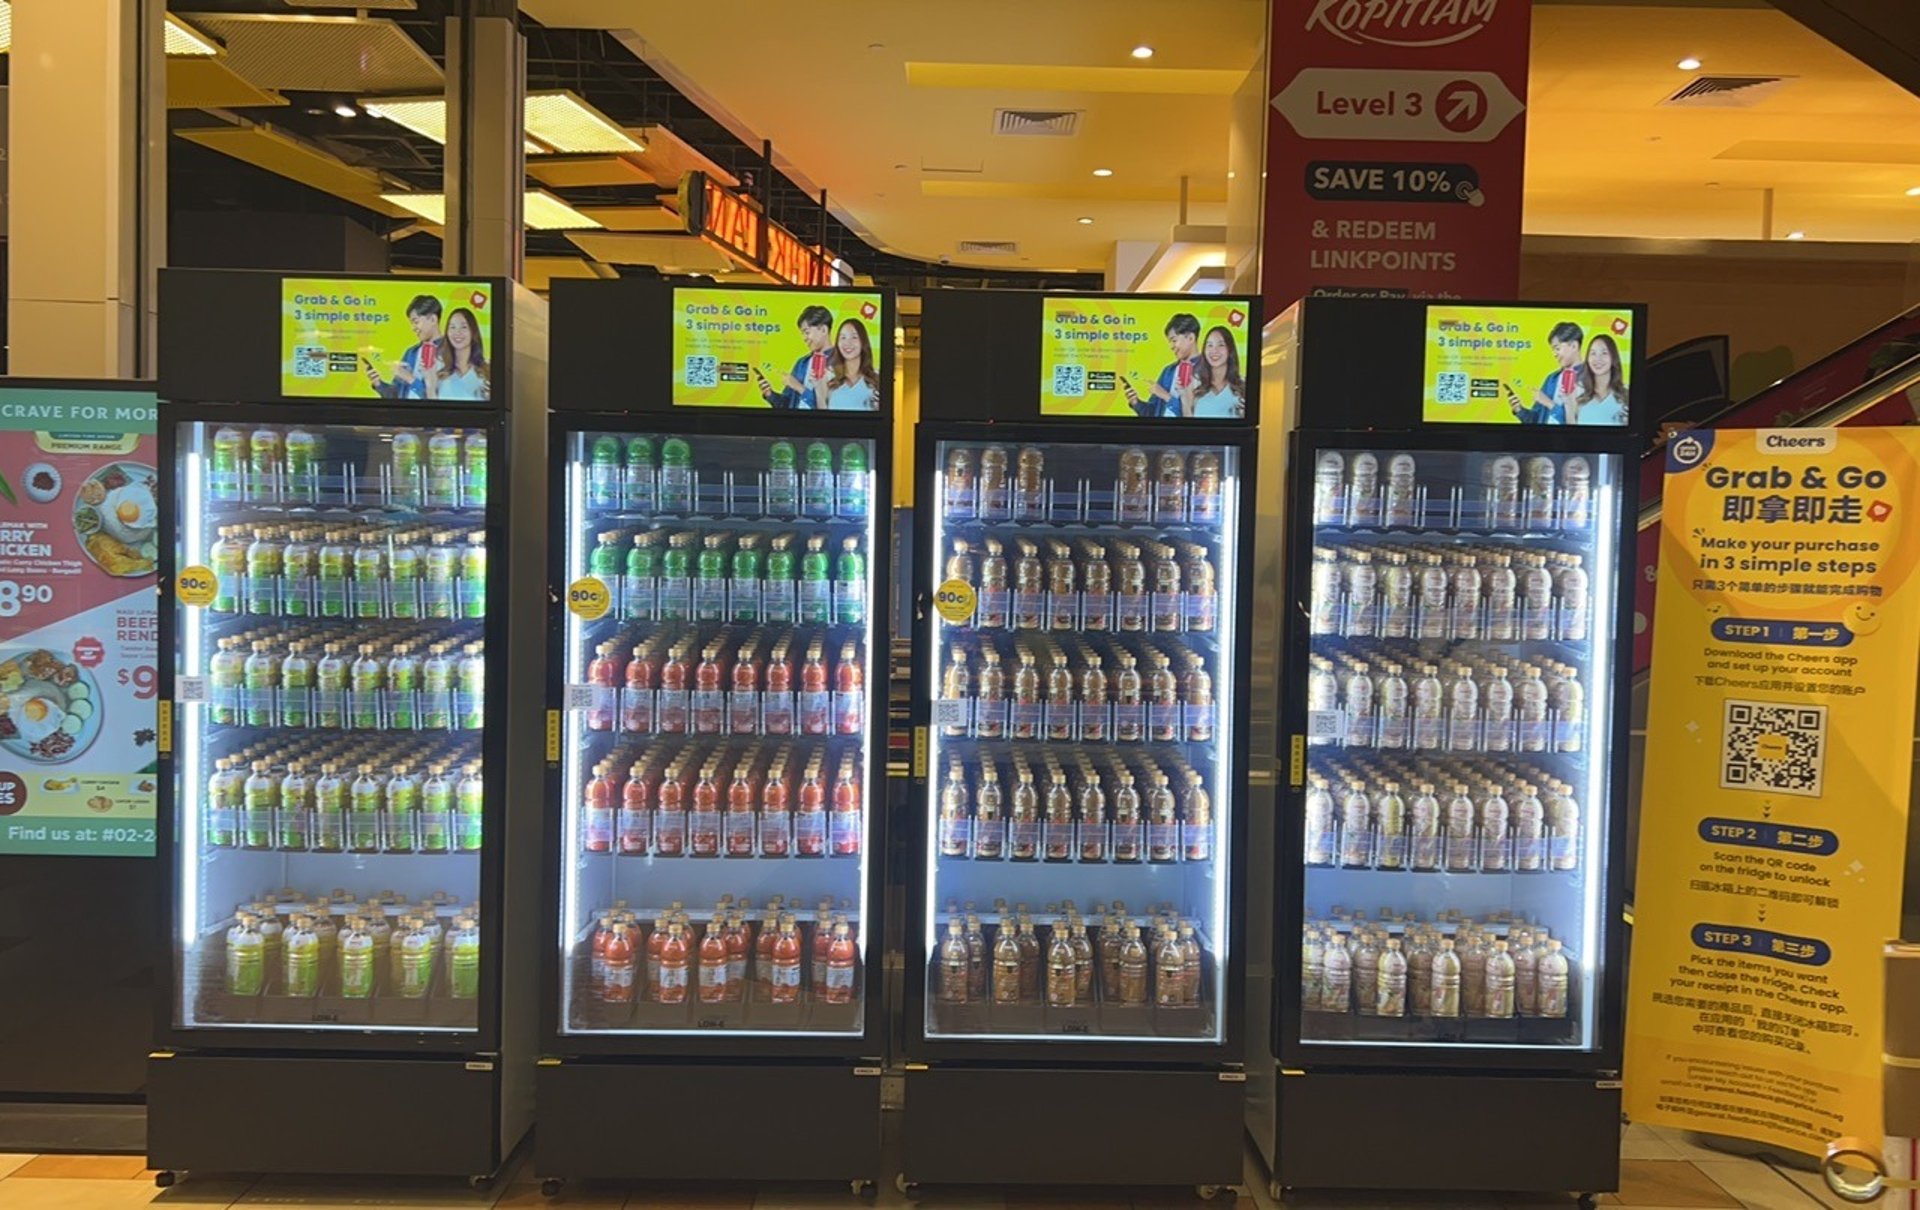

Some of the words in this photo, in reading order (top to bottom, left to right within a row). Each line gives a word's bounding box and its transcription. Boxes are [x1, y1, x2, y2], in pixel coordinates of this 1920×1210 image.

[1316, 91, 1395, 116] Level
[1405, 92, 1423, 117] 3
[1313, 168, 1384, 190] SAVE
[1393, 170, 1451, 193] 10%
[1311, 219, 1330, 239] &
[1336, 220, 1436, 240] REDEEM
[1310, 250, 1456, 271] LINKPOINTS
[295, 295, 327, 306] Grab
[331, 295, 339, 306] &
[343, 296, 361, 306] Go
[363, 296, 376, 306] in
[295, 310, 302, 321] 3
[304, 310, 350, 324] simple
[353, 312, 390, 325] steps
[686, 304, 719, 315] Grab
[722, 305, 730, 315] &
[735, 305, 752, 316] Go
[755, 305, 767, 316] in
[686, 319, 693, 329] 3
[696, 319, 742, 334] simple
[745, 322, 781, 335] steps
[1090, 314, 1099, 324] &
[1103, 314, 1120, 324] Go
[1123, 314, 1136, 325] in
[1474, 322, 1483, 332] &
[1486, 322, 1504, 333] Go
[1507, 322, 1519, 333] in
[1055, 329, 1062, 339] 3
[1065, 328, 1110, 342] simple
[1112, 331, 1149, 343] steps
[1438, 336, 1446, 347] 3
[1448, 336, 1492, 350] simple
[1496, 338, 1532, 351] steps
[1, 404, 63, 419] CRAVE
[70, 406, 108, 420] FOR
[1766, 435, 1826, 448] Cheers
[1705, 466, 1792, 489] Grab
[1801, 466, 1827, 489] &
[1837, 466, 1887, 489] Go
[1722, 495, 1863, 524] 即拿即走
[1701, 537, 1747, 550] Make
[1751, 540, 1790, 553] your
[1794, 540, 1880, 554] purchase
[1700, 554, 1719, 569] in
[1724, 556, 1735, 570] 3
[1740, 556, 1812, 576] simple
[1817, 559, 1877, 577] steps
[1724, 624, 1761, 637] STEP
[1763, 626, 1769, 637] 1
[1792, 626, 1840, 641] 第一步
[1704, 648, 1762, 660] Download
[1765, 651, 1785, 661] the
[1787, 652, 1830, 664] Cheers
[1833, 656, 1858, 667] app
[1707, 660, 1729, 669] and
[1732, 662, 1750, 670] set
[1753, 664, 1769, 674] up
[1772, 665, 1799, 675] your
[1801, 666, 1852, 677] account
[8, 826, 46, 840] Find
[51, 829, 70, 840] us
[75, 829, 97, 841] at:
[102, 829, 158, 842] #02-2
[1711, 825, 1745, 838] STEP
[1747, 828, 1757, 840] 2
[1777, 830, 1824, 848] 第二步
[1714, 851, 1742, 863] Scan
[1745, 854, 1764, 865] the
[1767, 857, 1783, 868] QR
[1786, 860, 1817, 872] code
[1700, 863, 1713, 872] on
[1715, 864, 1735, 874] the
[1737, 866, 1772, 880] fridge
[1774, 871, 1786, 880] to
[1789, 874, 1831, 887] unlock
[1704, 931, 1740, 945] STEP
[1742, 934, 1752, 946] 3
[1772, 938, 1817, 958] 第三步
[1691, 954, 1713, 965] Pick
[1717, 956, 1735, 967] the
[1738, 960, 1771, 973] items
[1774, 966, 1794, 978] you
[1797, 972, 1828, 984] want
[1678, 965, 1704, 976] then
[1707, 968, 1737, 980] close
[1740, 972, 1760, 983] the
[1762, 974, 1797, 992] fridge.
[1800, 984, 1840, 999] Check
[1669, 977, 1695, 987] your
[1697, 978, 1739, 994] receipt
[1741, 984, 1752, 995] in
[1755, 987, 1774, 999] the
[1776, 991, 1817, 1009] Cheers
[1819, 1002, 1848, 1016] app.
